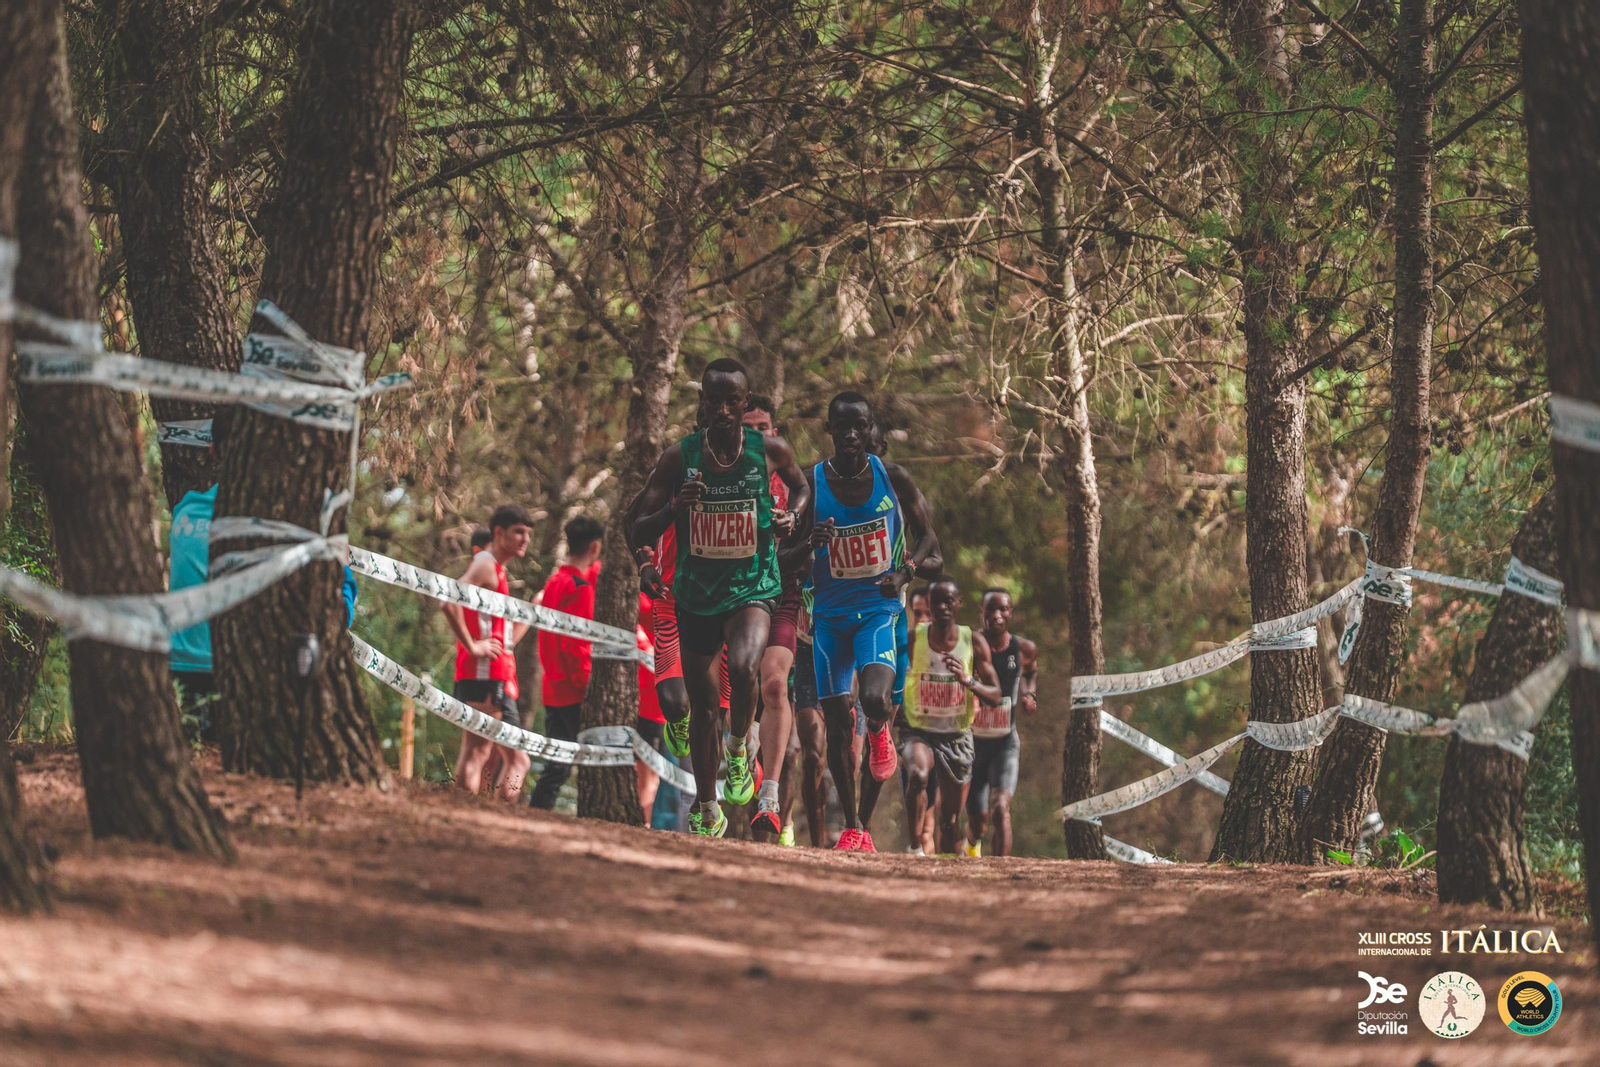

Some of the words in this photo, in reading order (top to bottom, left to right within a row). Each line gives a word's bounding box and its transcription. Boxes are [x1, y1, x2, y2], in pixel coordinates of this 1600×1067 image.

[705, 485, 739, 495] Facsa
[691, 511, 755, 547] KWIZERA
[828, 528, 887, 568] KIBET
